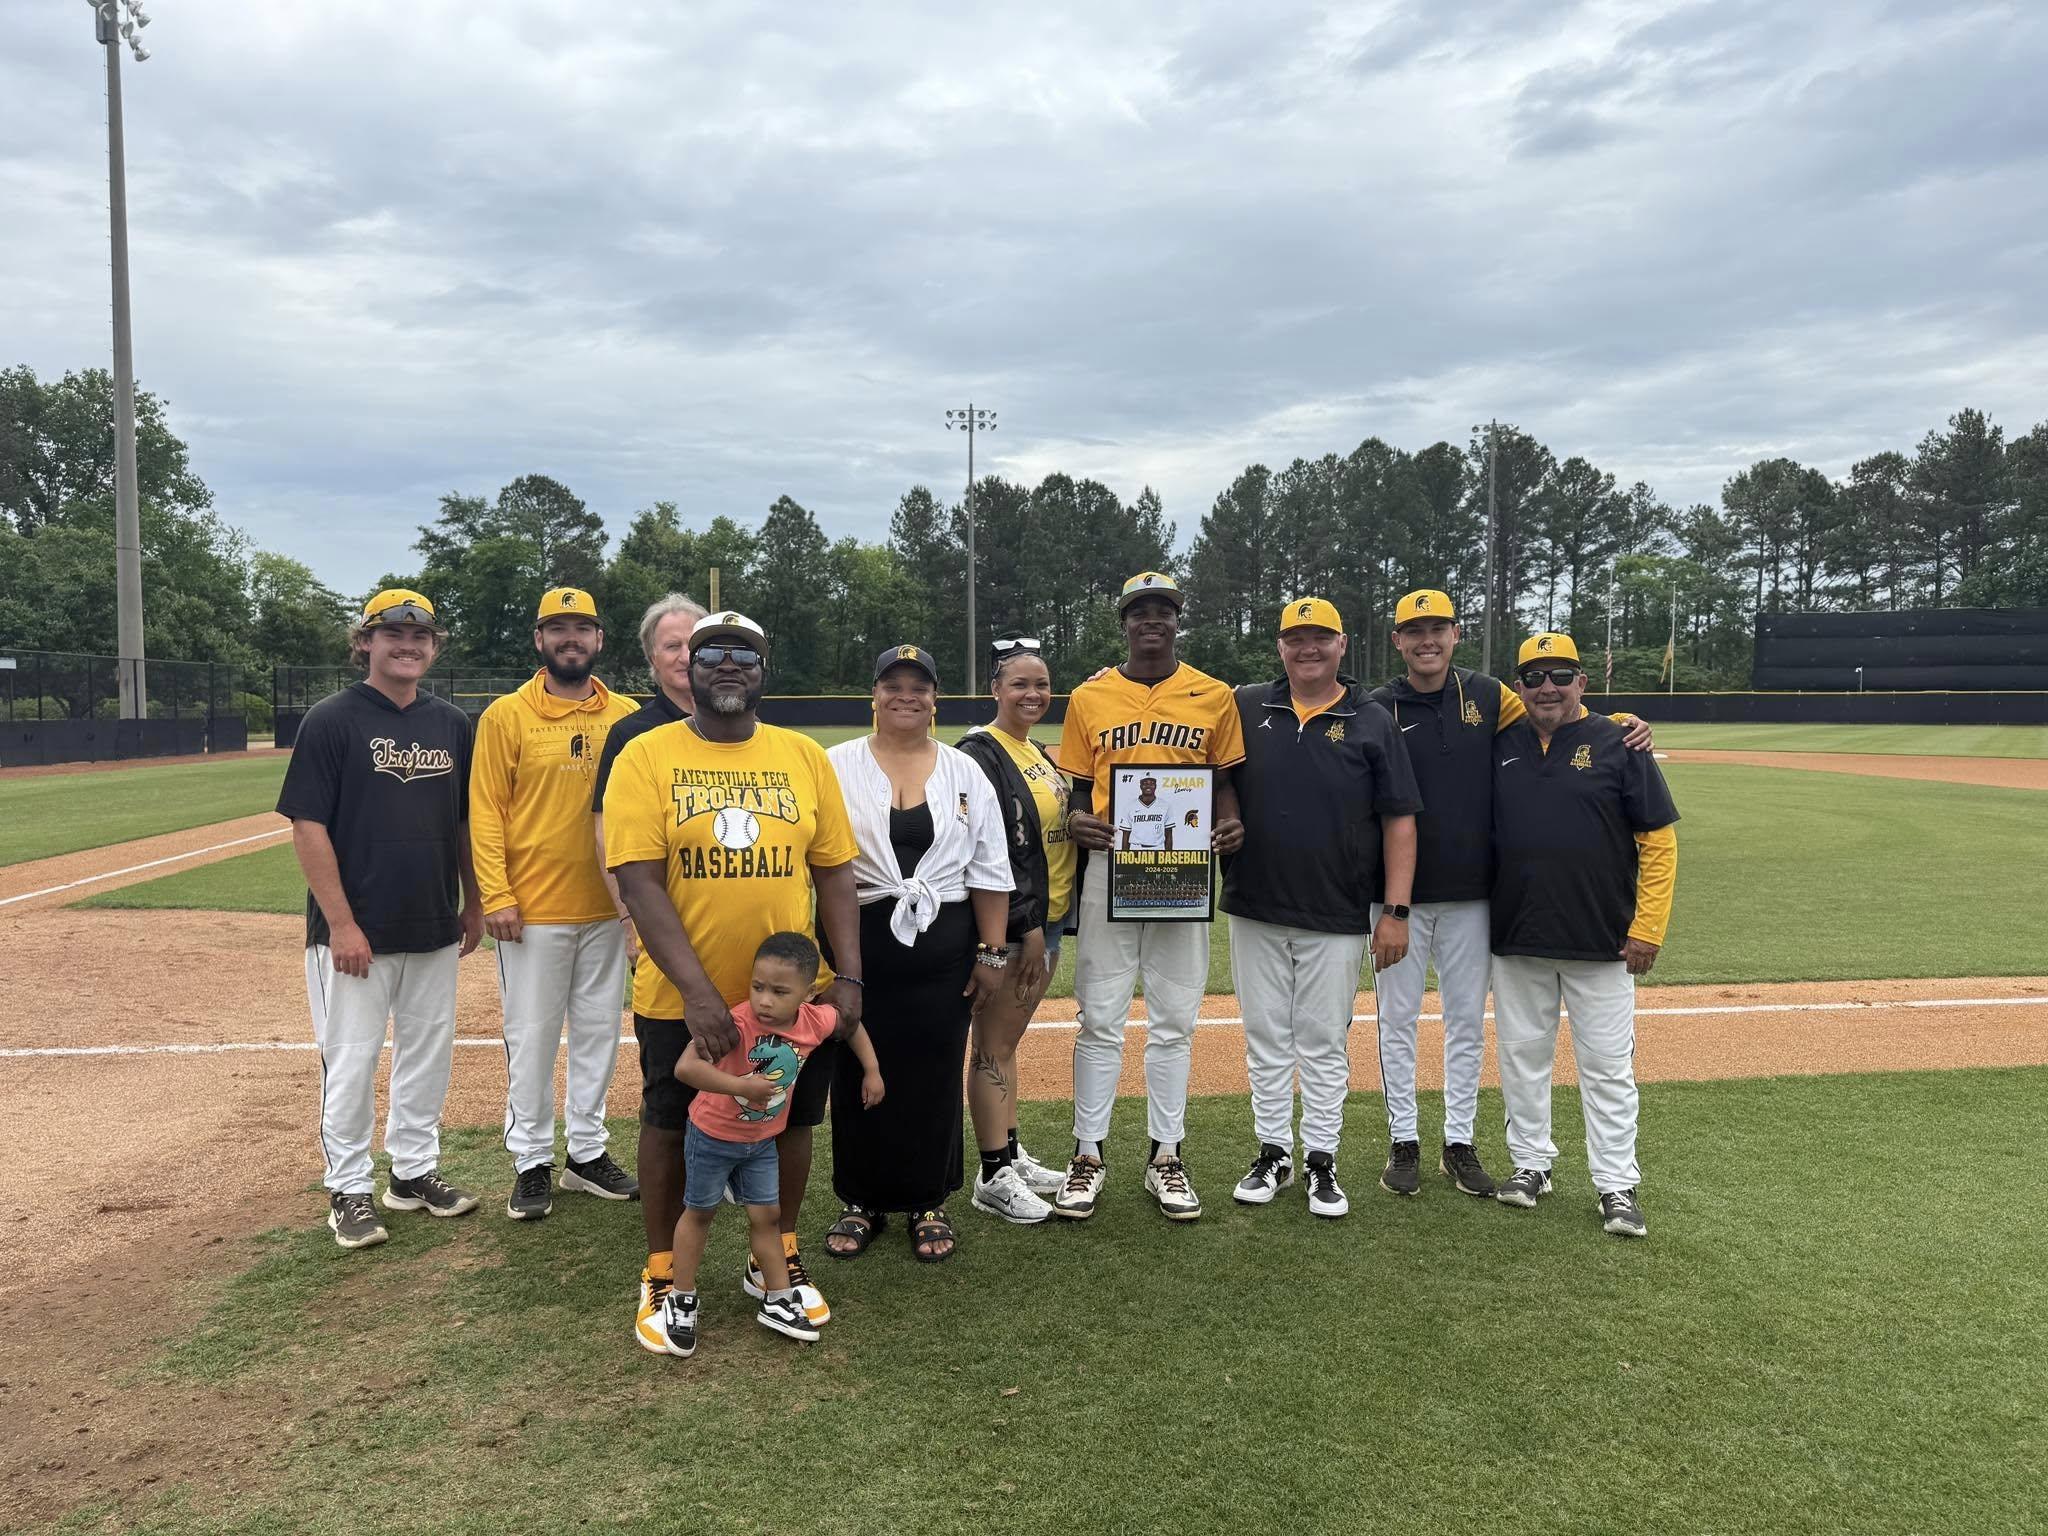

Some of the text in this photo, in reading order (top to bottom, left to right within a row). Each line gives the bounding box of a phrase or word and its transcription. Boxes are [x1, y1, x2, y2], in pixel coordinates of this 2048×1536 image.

[1098, 721, 1205, 752] TROJANS
[370, 738, 453, 777] Trojans
[673, 768, 790, 787] FAYETTEVILLE TECH
[1122, 774, 1134, 783] #7
[1162, 776, 1205, 789] ZAMAR
[672, 784, 800, 827] TROJANS
[679, 846, 794, 879] BASEBALL
[1115, 851, 1208, 864] TROJAN BASEBALL
